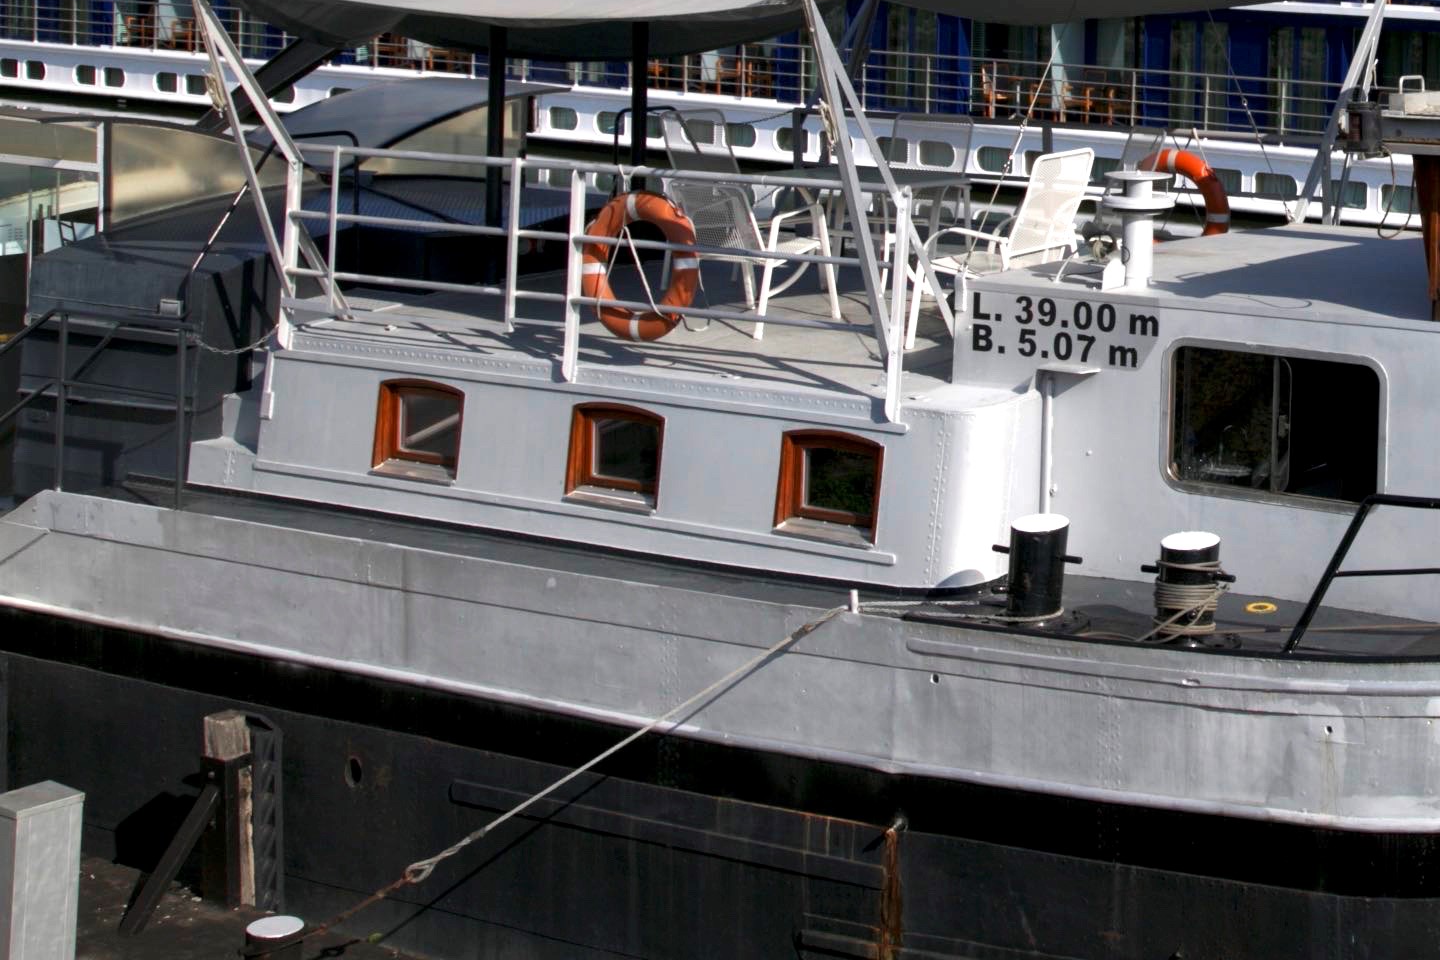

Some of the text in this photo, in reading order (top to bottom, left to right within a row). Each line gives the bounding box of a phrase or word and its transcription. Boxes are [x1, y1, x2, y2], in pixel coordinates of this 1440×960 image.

[972, 292, 1160, 337] L. 39.00 m
[972, 324, 1138, 368] B. 5.07 m
